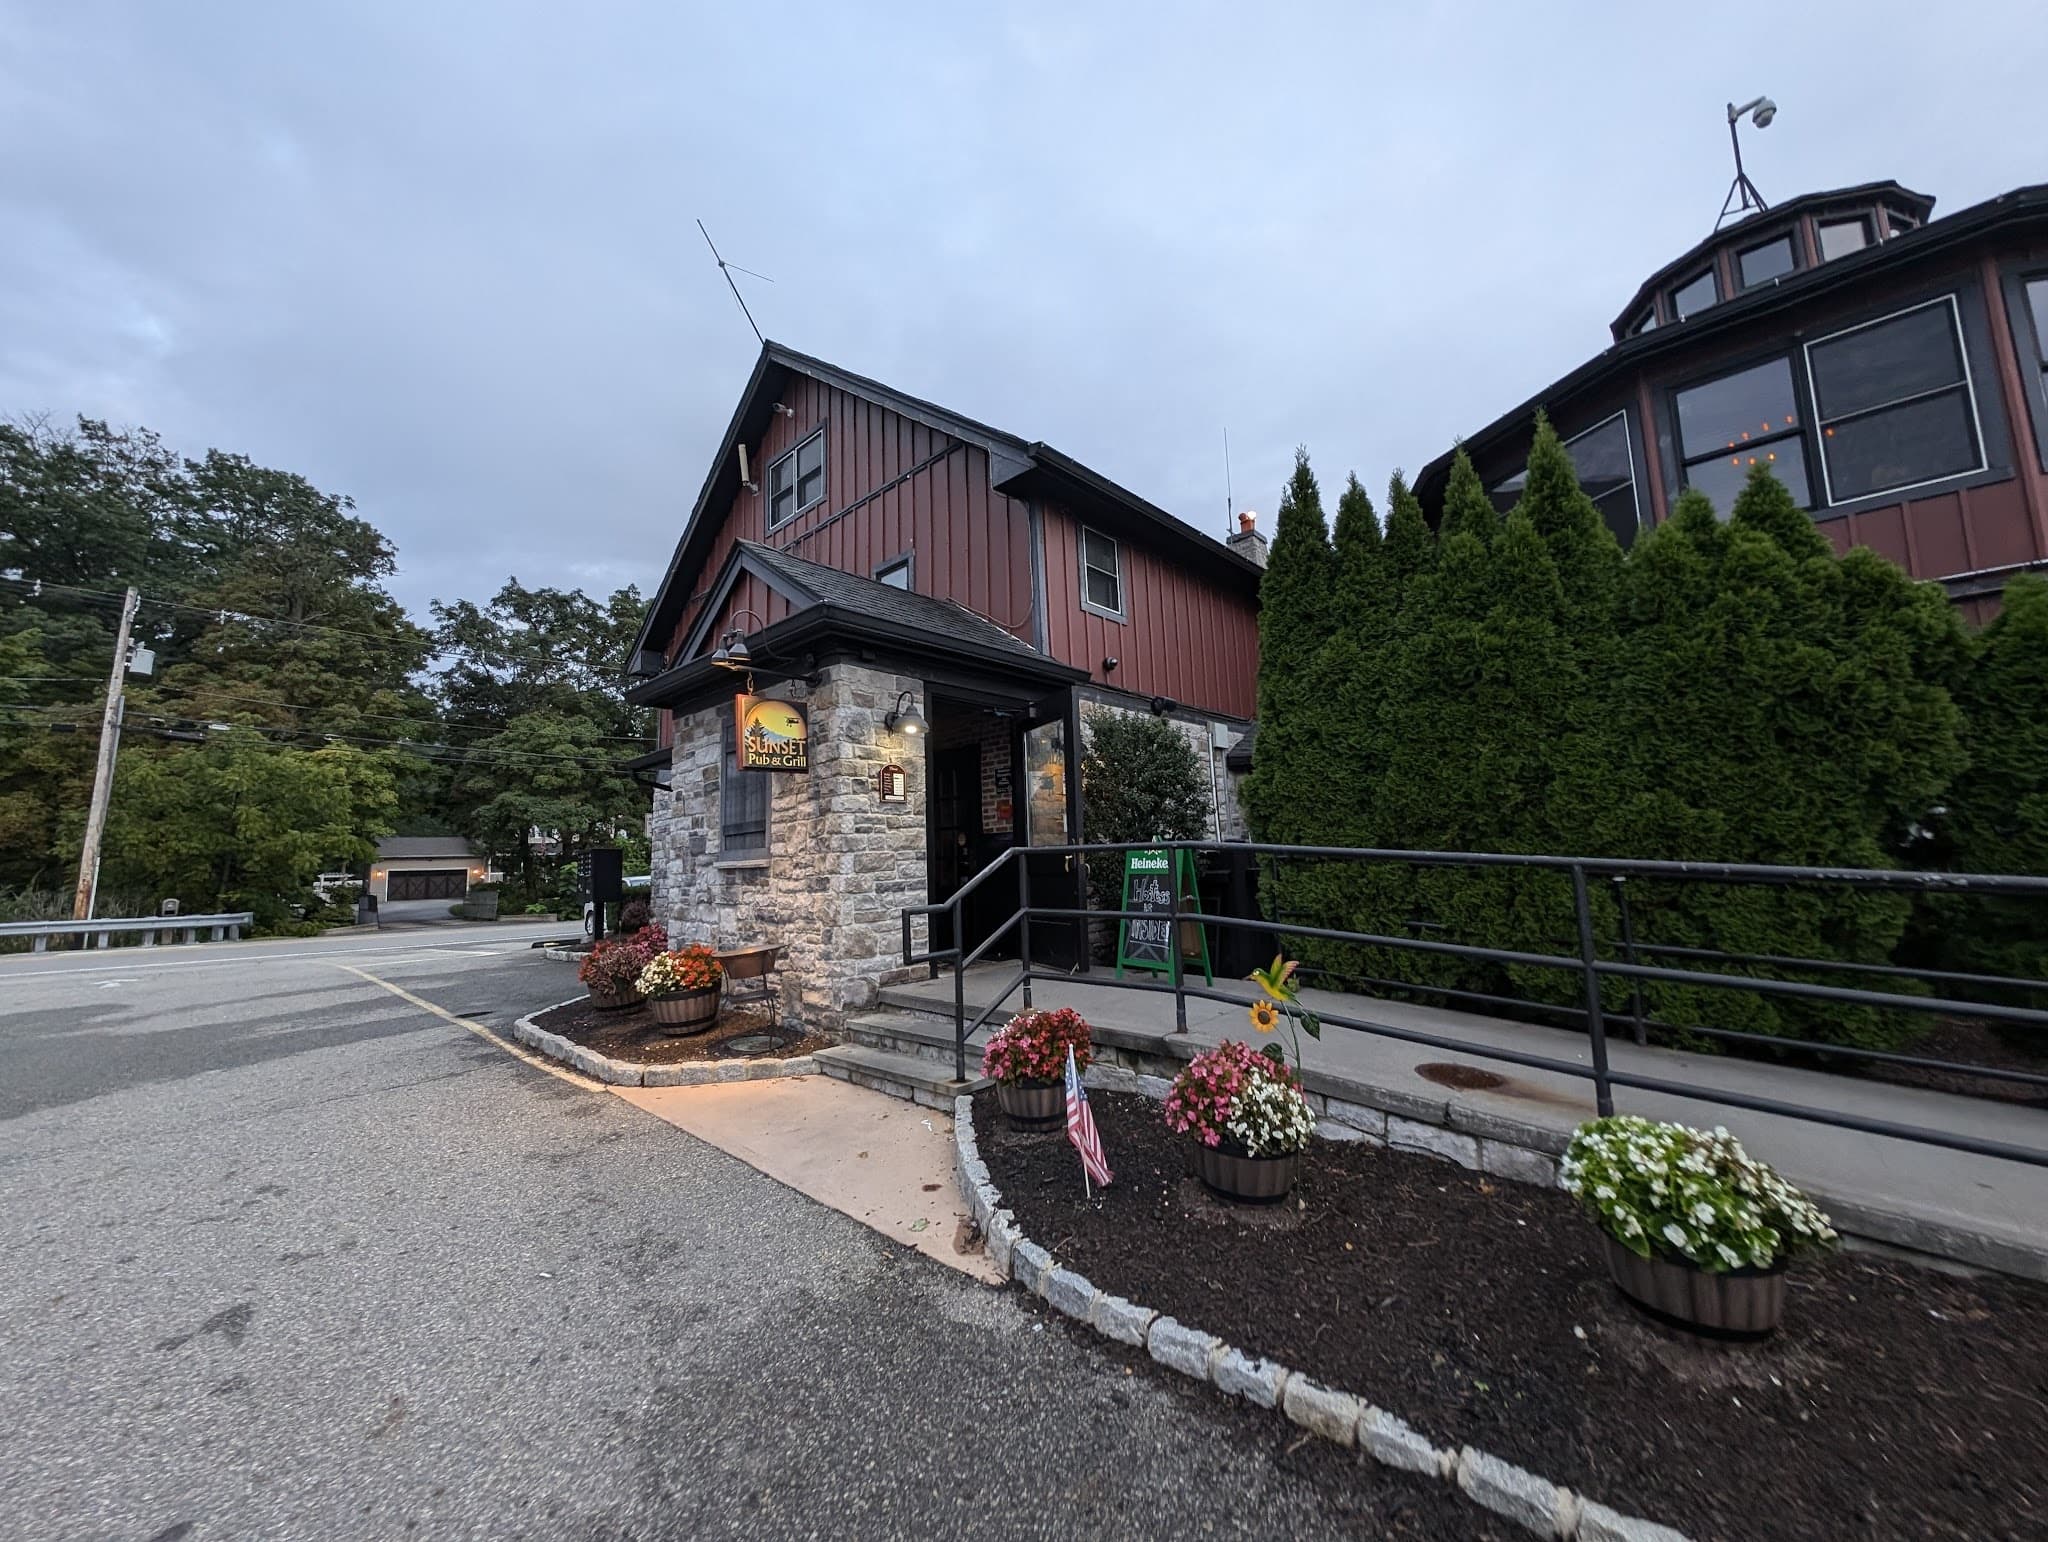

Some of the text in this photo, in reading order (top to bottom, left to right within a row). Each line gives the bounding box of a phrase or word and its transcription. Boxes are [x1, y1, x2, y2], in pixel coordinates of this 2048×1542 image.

[748, 736, 806, 755] SUNSET
[748, 752, 807, 767] Pub & Grill
[1131, 857, 1169, 869] Heineke
[1133, 879, 1170, 905] Hostess
